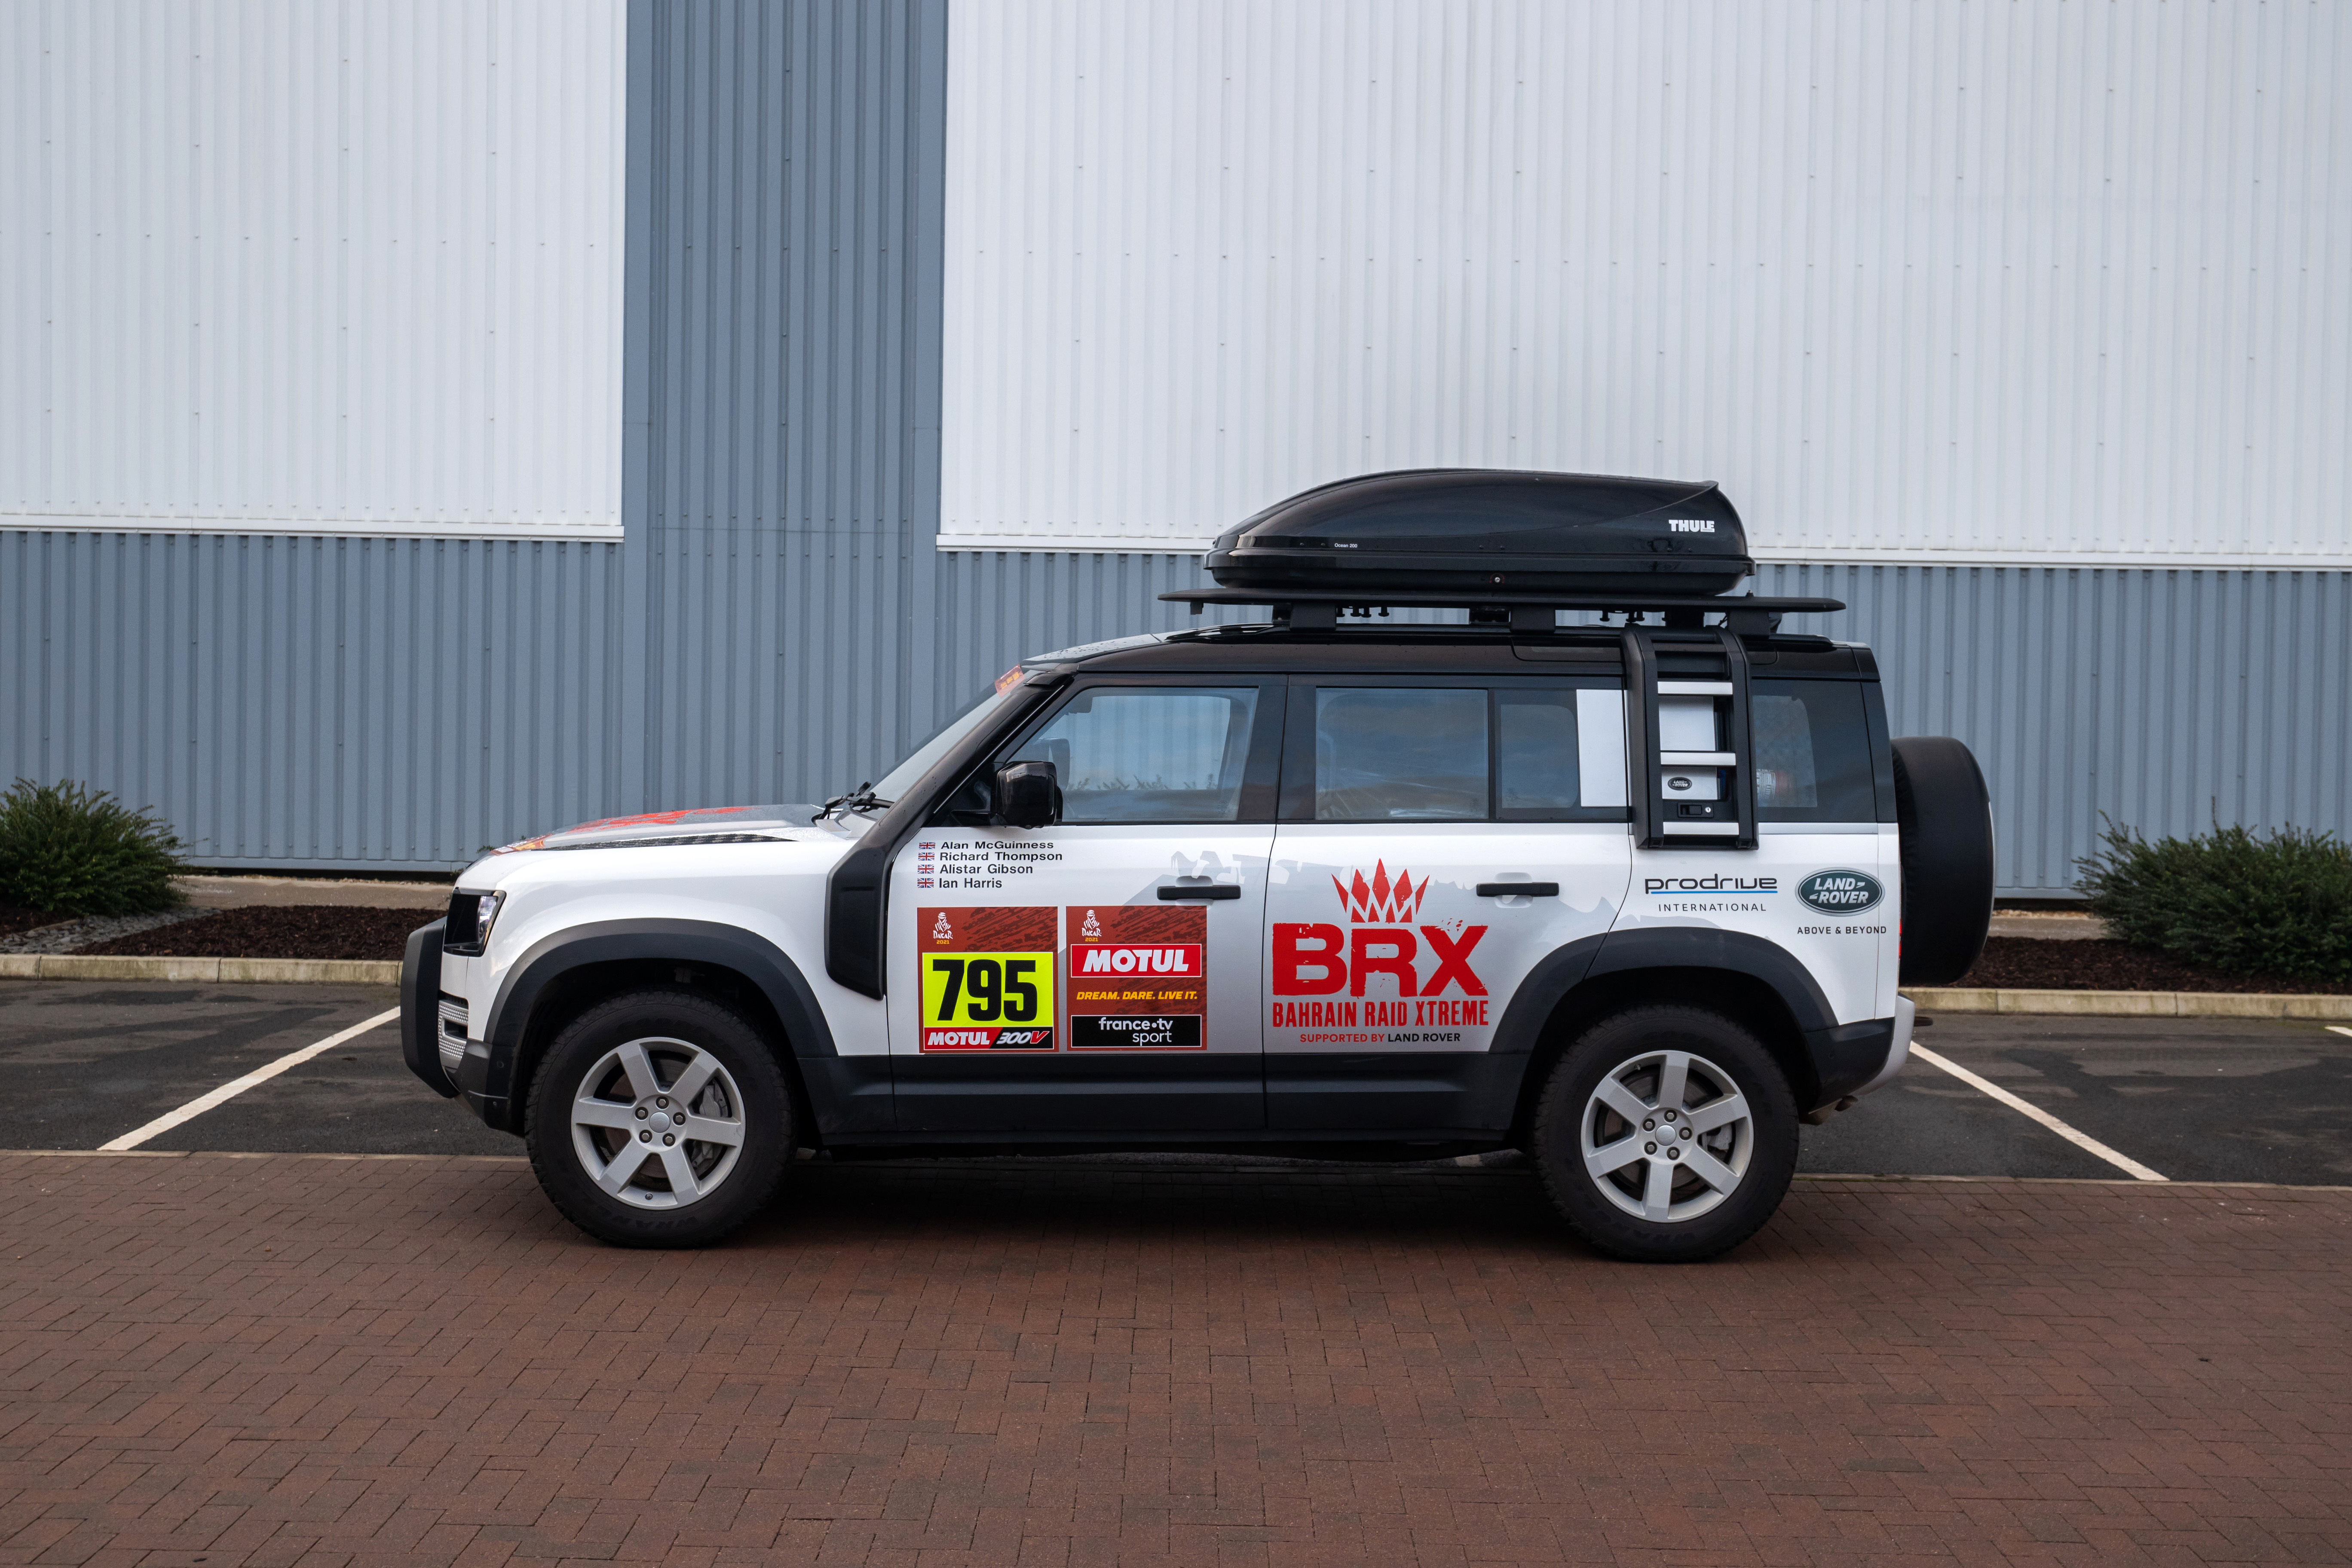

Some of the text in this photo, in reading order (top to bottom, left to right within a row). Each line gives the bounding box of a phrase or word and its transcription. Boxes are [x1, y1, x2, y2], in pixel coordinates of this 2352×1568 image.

[1669, 520, 1715, 533] THULE
[975, 841, 1054, 849] McGuinness
[940, 852, 1063, 862] Richard Thompson
[940, 864, 1033, 874] Alistar Gibson
[939, 878, 1002, 888] Ian Harris
[1814, 878, 1856, 890] LAND
[1818, 891, 1869, 903] ROVER
[1659, 903, 1766, 912] INTERNATIONAL
[933, 930, 953, 940] DAKAR
[1081, 927, 1102, 937] DAKAR
[1797, 926, 1831, 934] ABOVE
[1846, 926, 1886, 934] BEYOND
[1082, 949, 1189, 972] MOTUL
[1272, 922, 1489, 998] BRX
[932, 959, 1038, 1022] 795
[1076, 991, 1197, 1000] DREAM. DARE. LIVE IT.
[1272, 1000, 1489, 1027] BAHRAIN RAID XTREME
[927, 1031, 1050, 1045] MOTUL 300V
[1132, 1031, 1172, 1046] sport
[1300, 1033, 1461, 1043] SUPPORTED BY LAND ROVER
